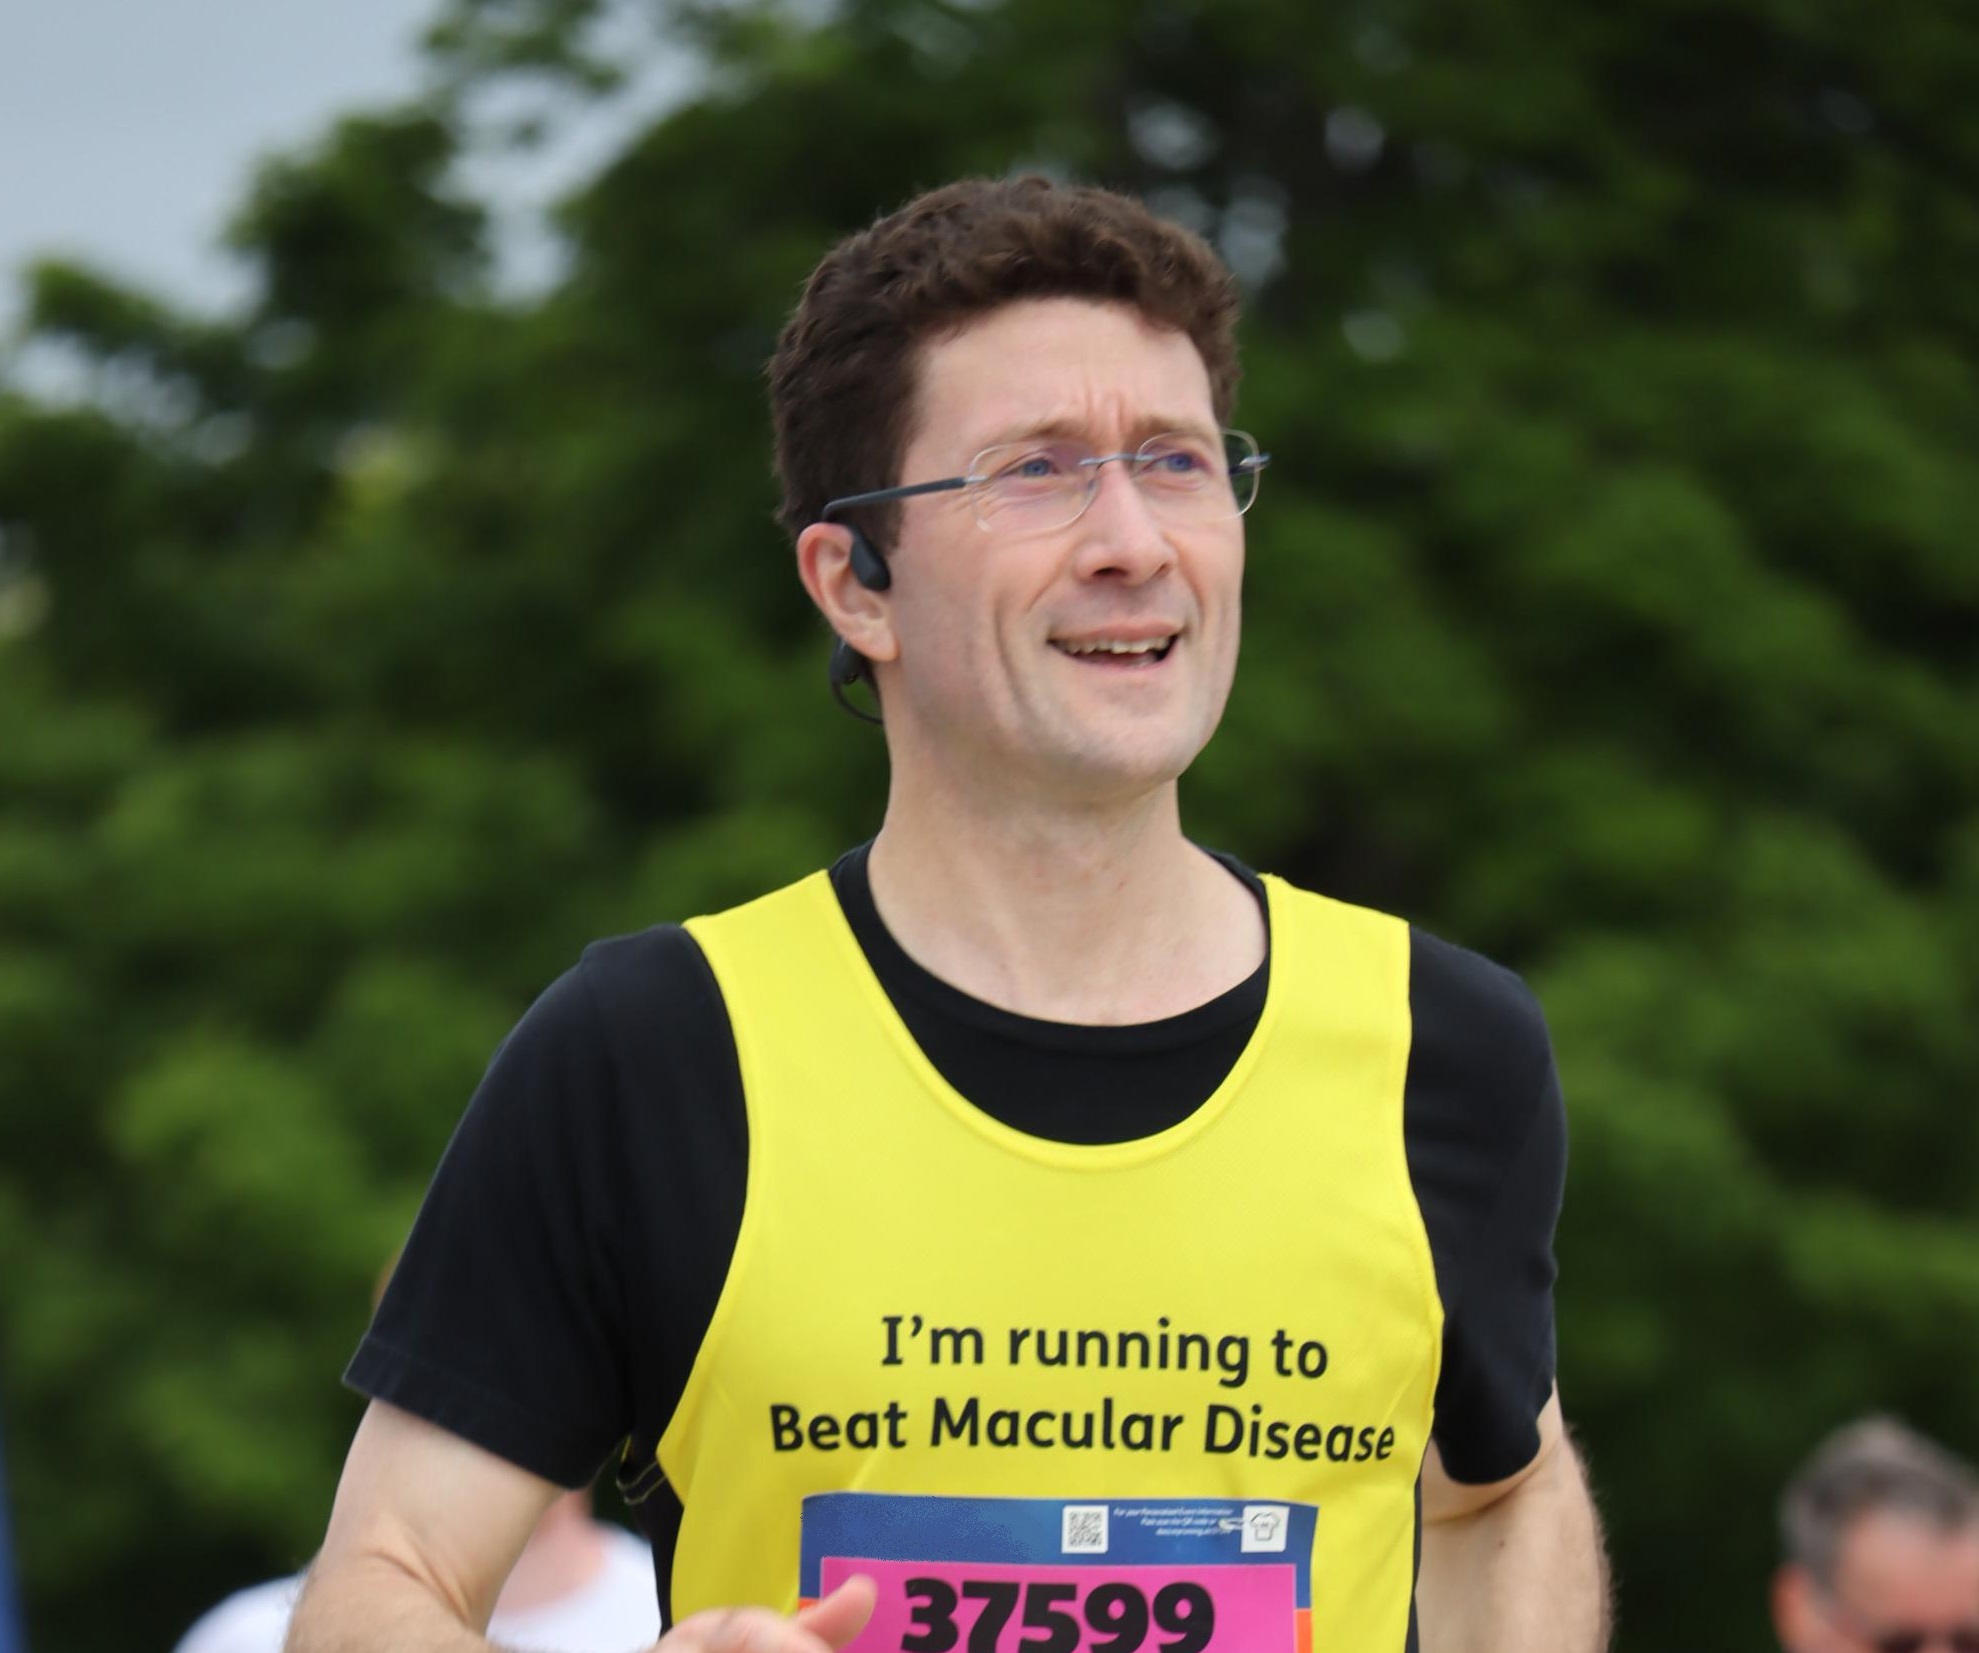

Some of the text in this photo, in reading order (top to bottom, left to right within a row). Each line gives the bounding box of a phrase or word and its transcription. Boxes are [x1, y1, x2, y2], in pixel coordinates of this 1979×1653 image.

[881, 1315, 1328, 1389] I’m running to
[769, 1397, 1395, 1463] Beat Macular Disease
[900, 1577, 1215, 1653] 37599
